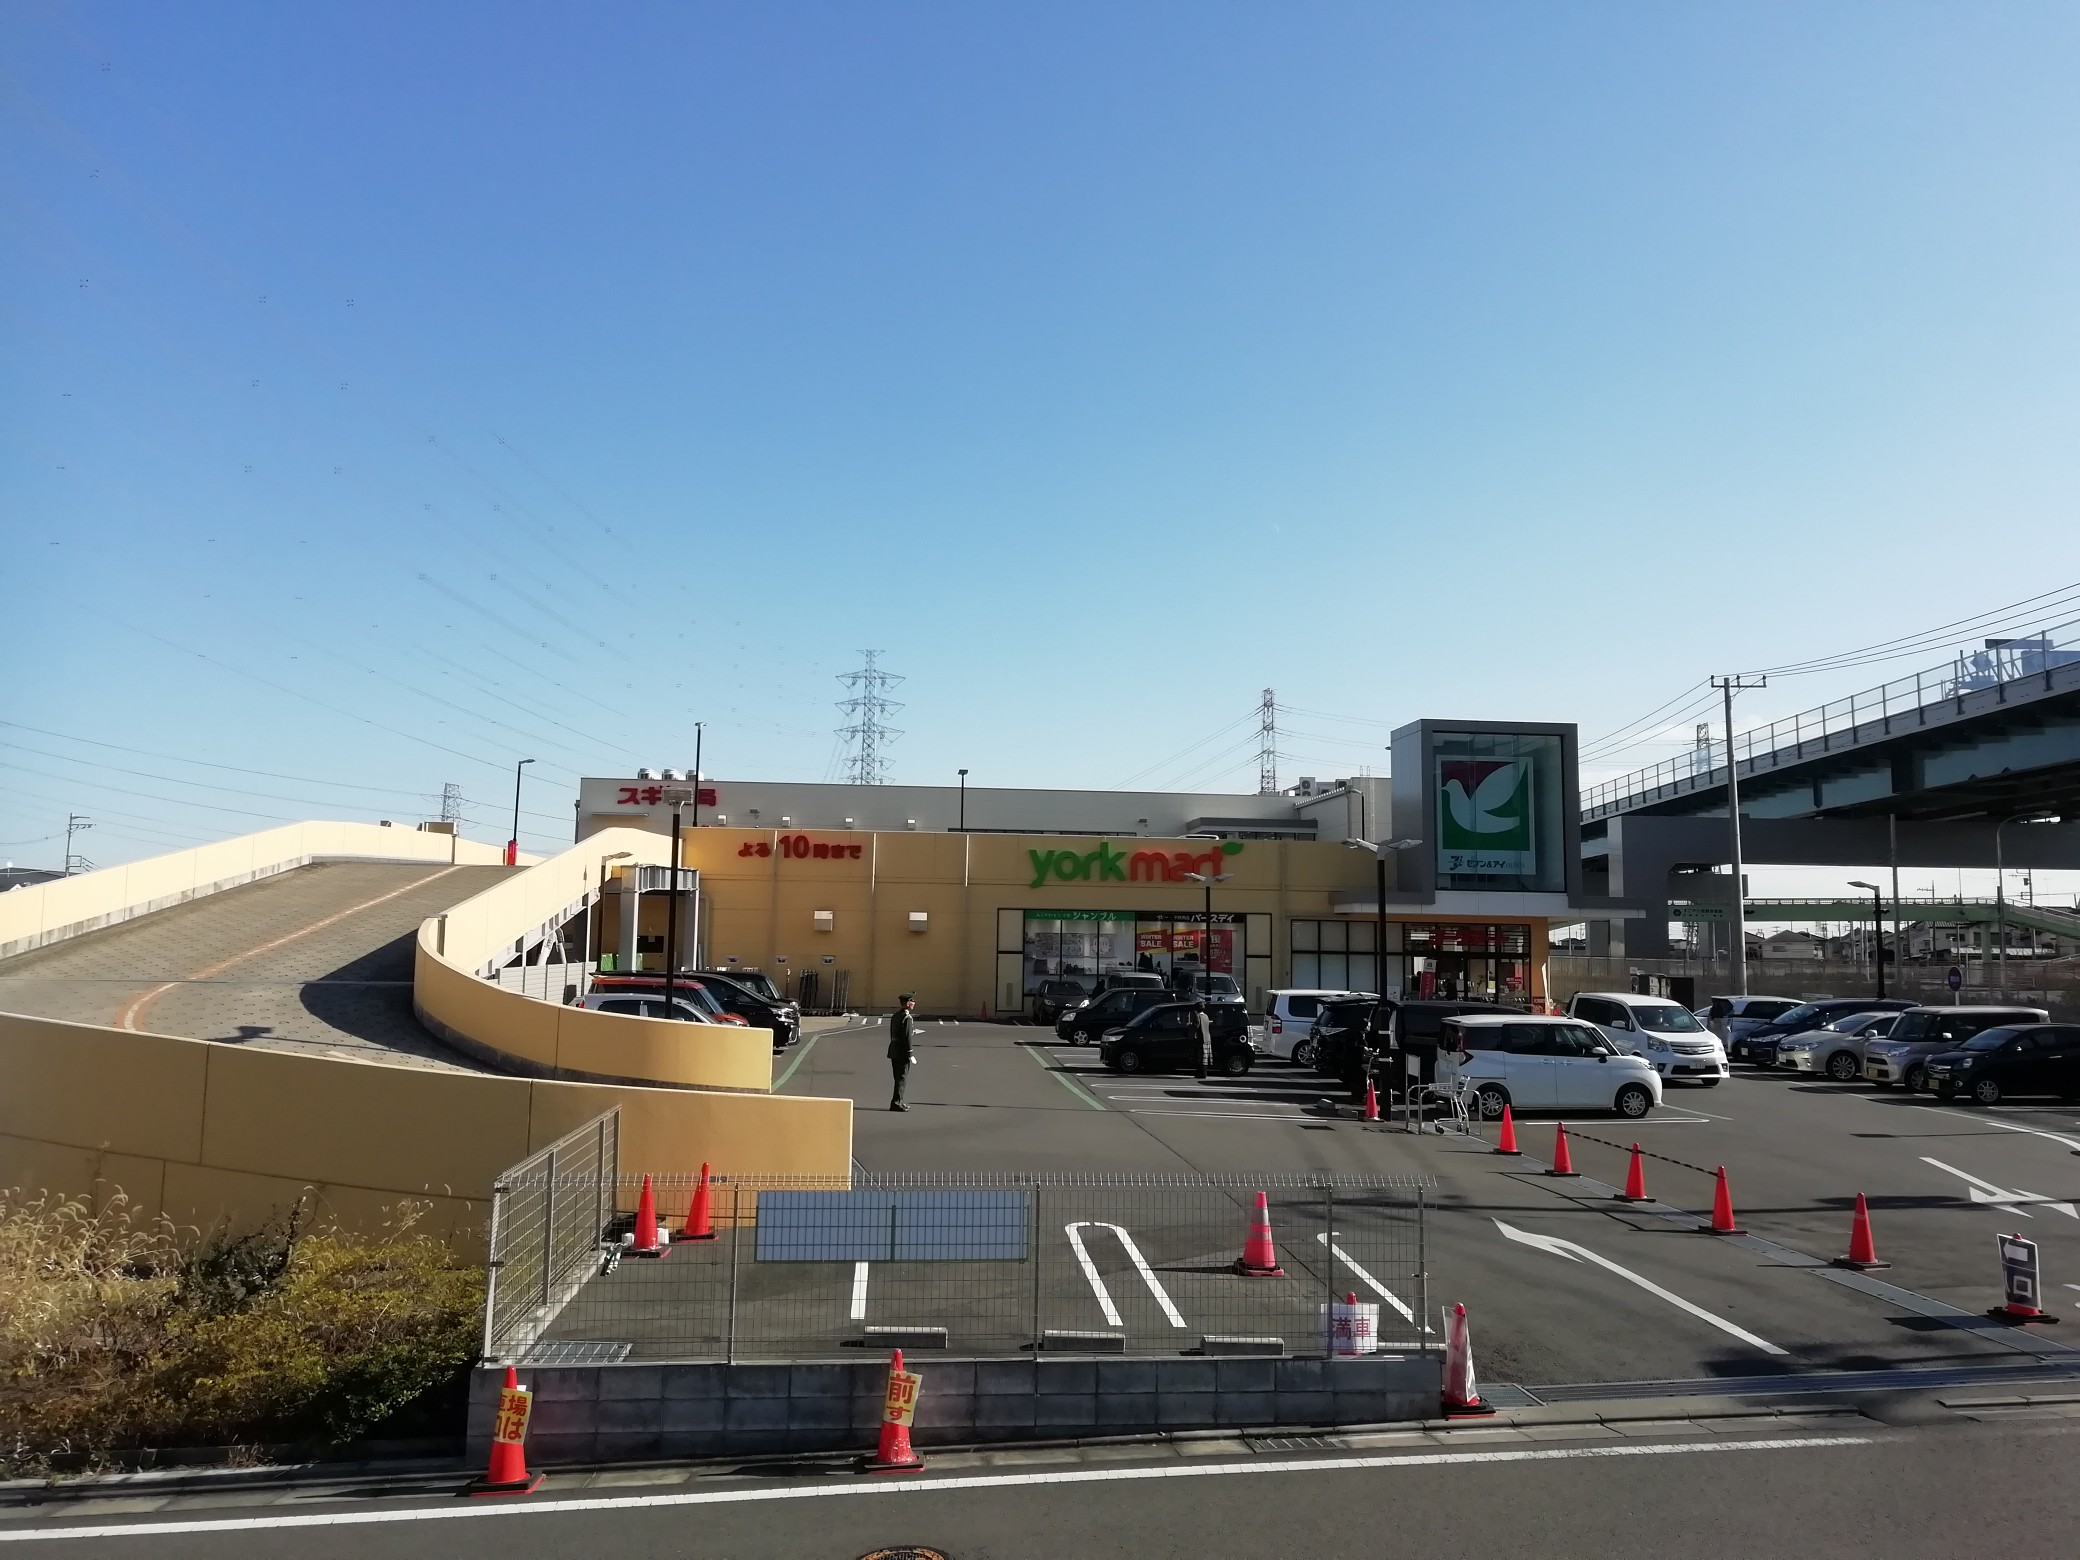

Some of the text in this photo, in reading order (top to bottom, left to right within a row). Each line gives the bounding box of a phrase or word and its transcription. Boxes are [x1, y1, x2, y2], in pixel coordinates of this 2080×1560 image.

[617, 785, 717, 806] スギ局
[1072, 911, 1117, 921] シャンブル
[1140, 940, 1162, 948] SALE
[1173, 940, 1194, 949] SALE
[888, 1373, 917, 1404] 前
[886, 1405, 912, 1421] す
